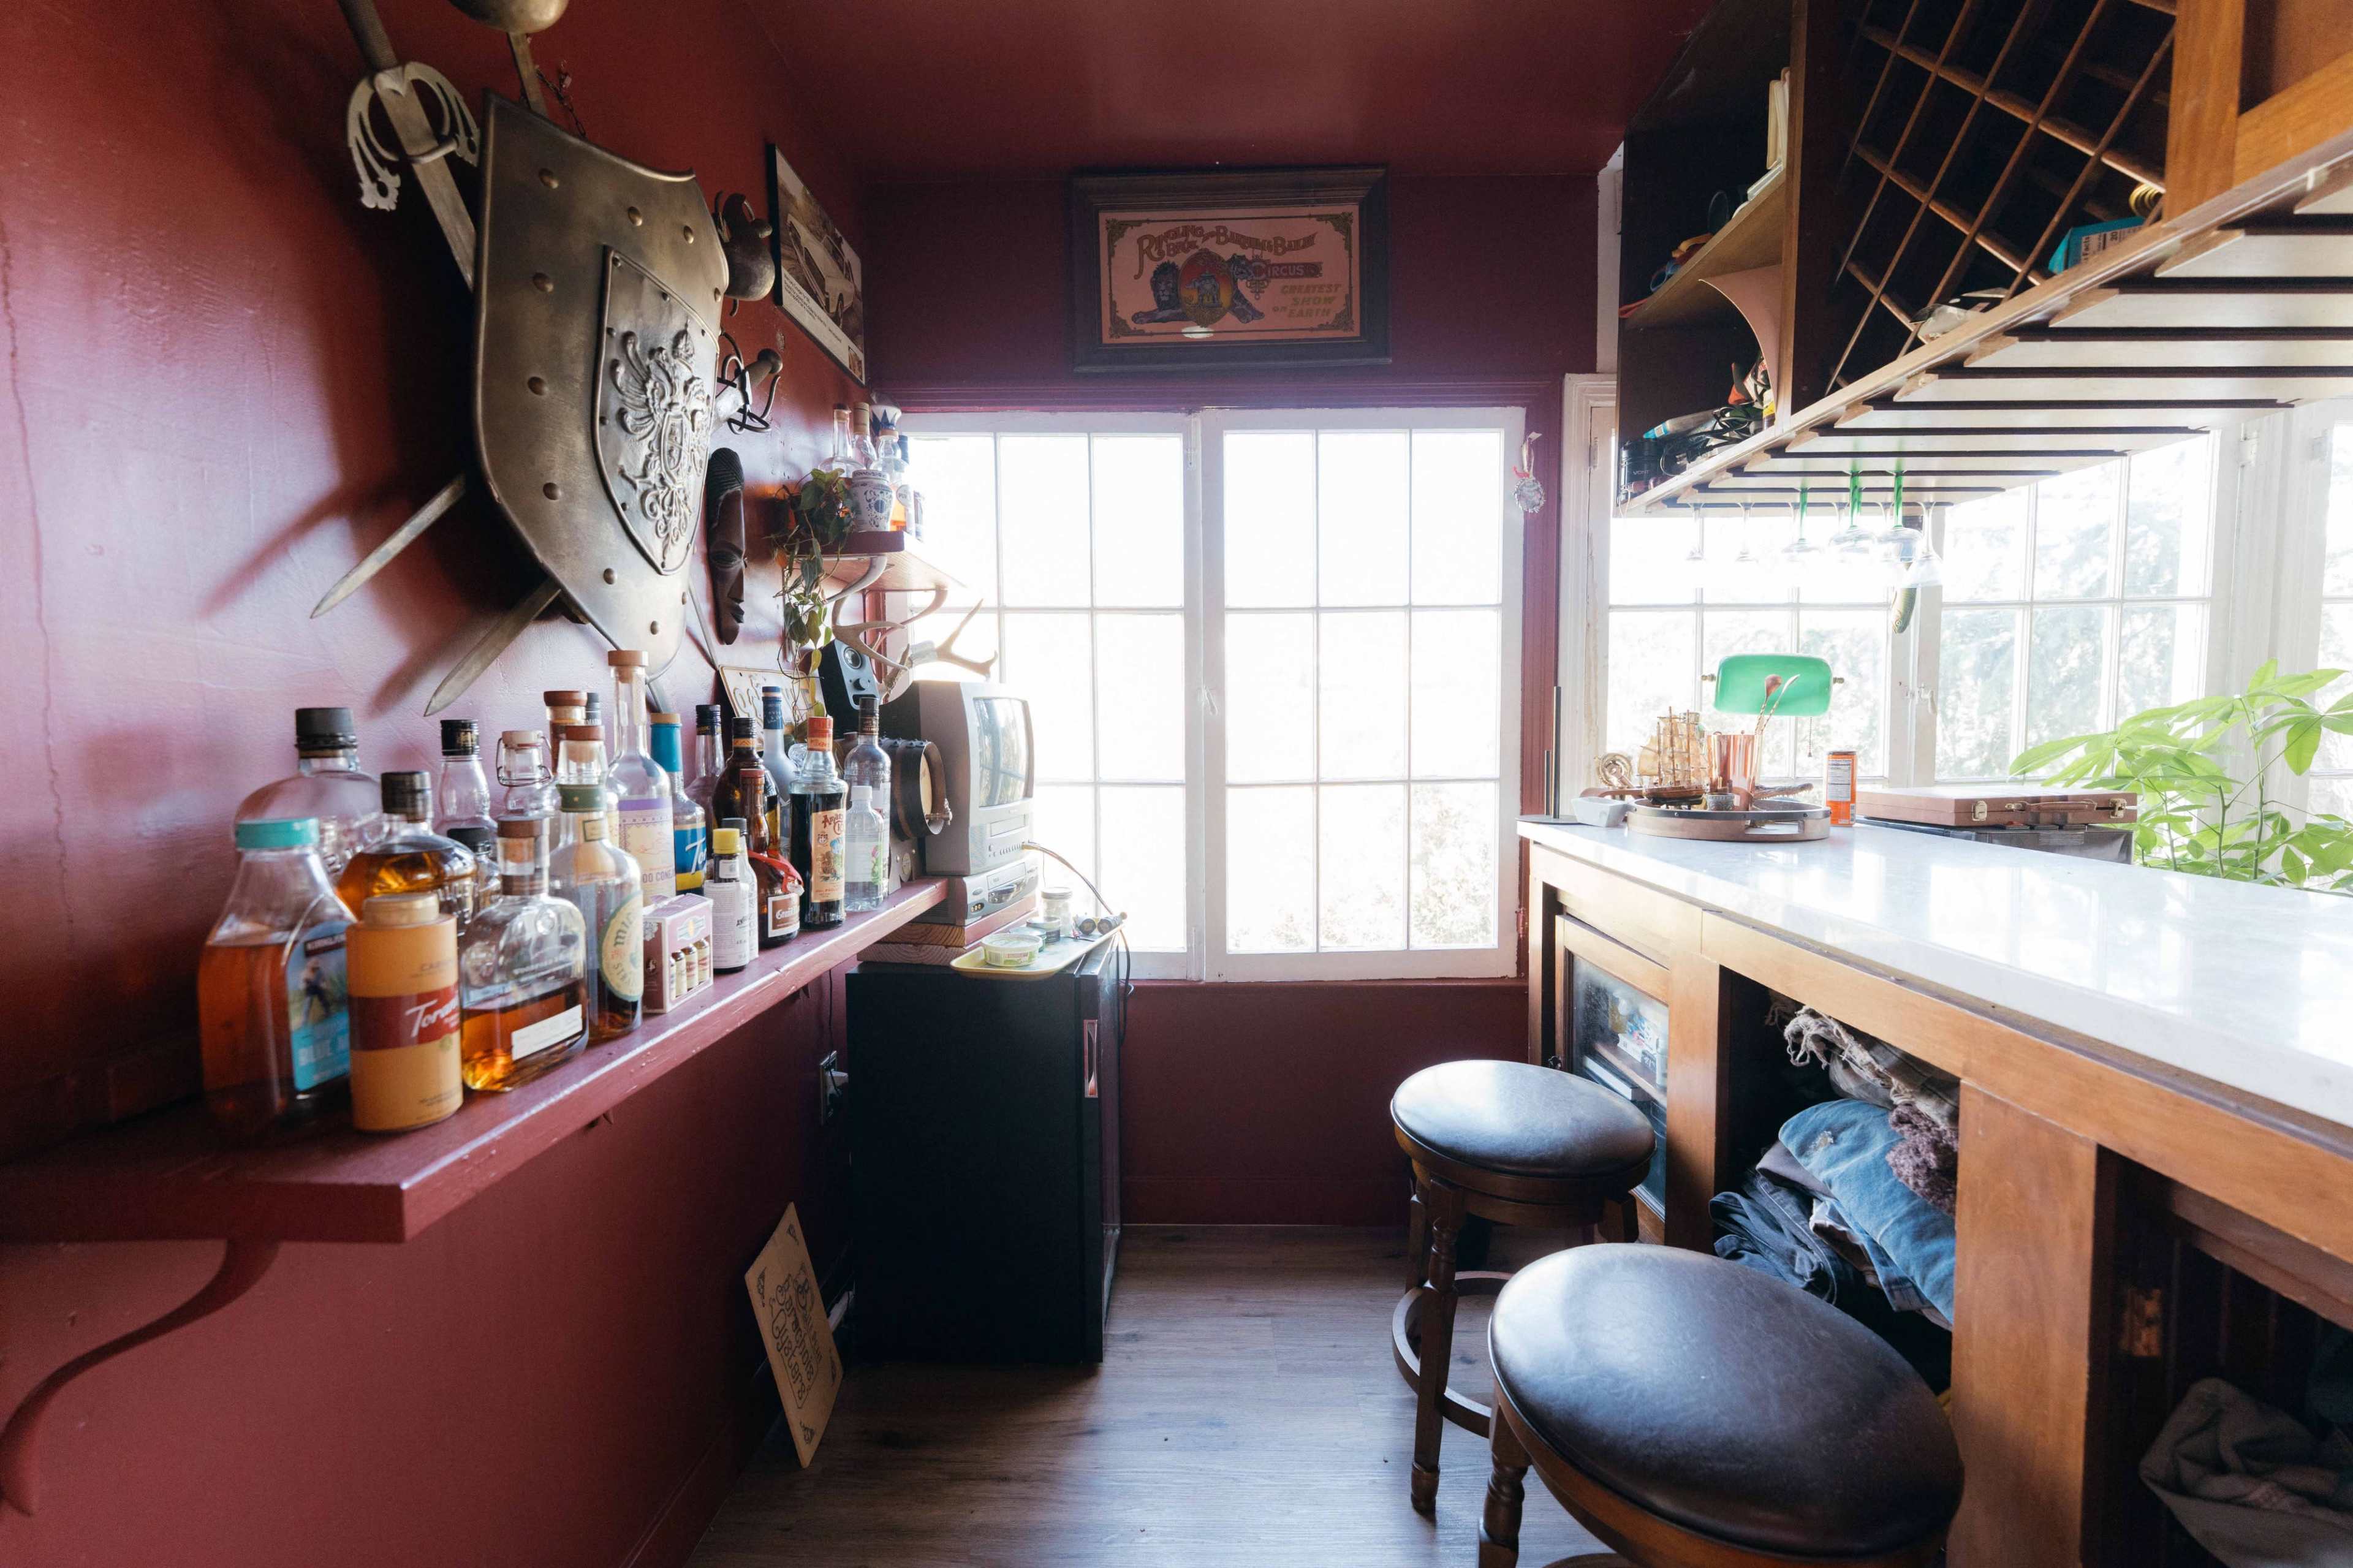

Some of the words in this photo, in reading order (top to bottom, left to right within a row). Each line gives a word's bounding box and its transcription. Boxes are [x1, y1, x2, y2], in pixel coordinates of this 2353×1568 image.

[1251, 261, 1305, 281] CIRCUS
[1279, 283, 1342, 295] GREATEST
[1292, 296, 1336, 306] SHOW
[1288, 308, 1332, 319] EARTH
